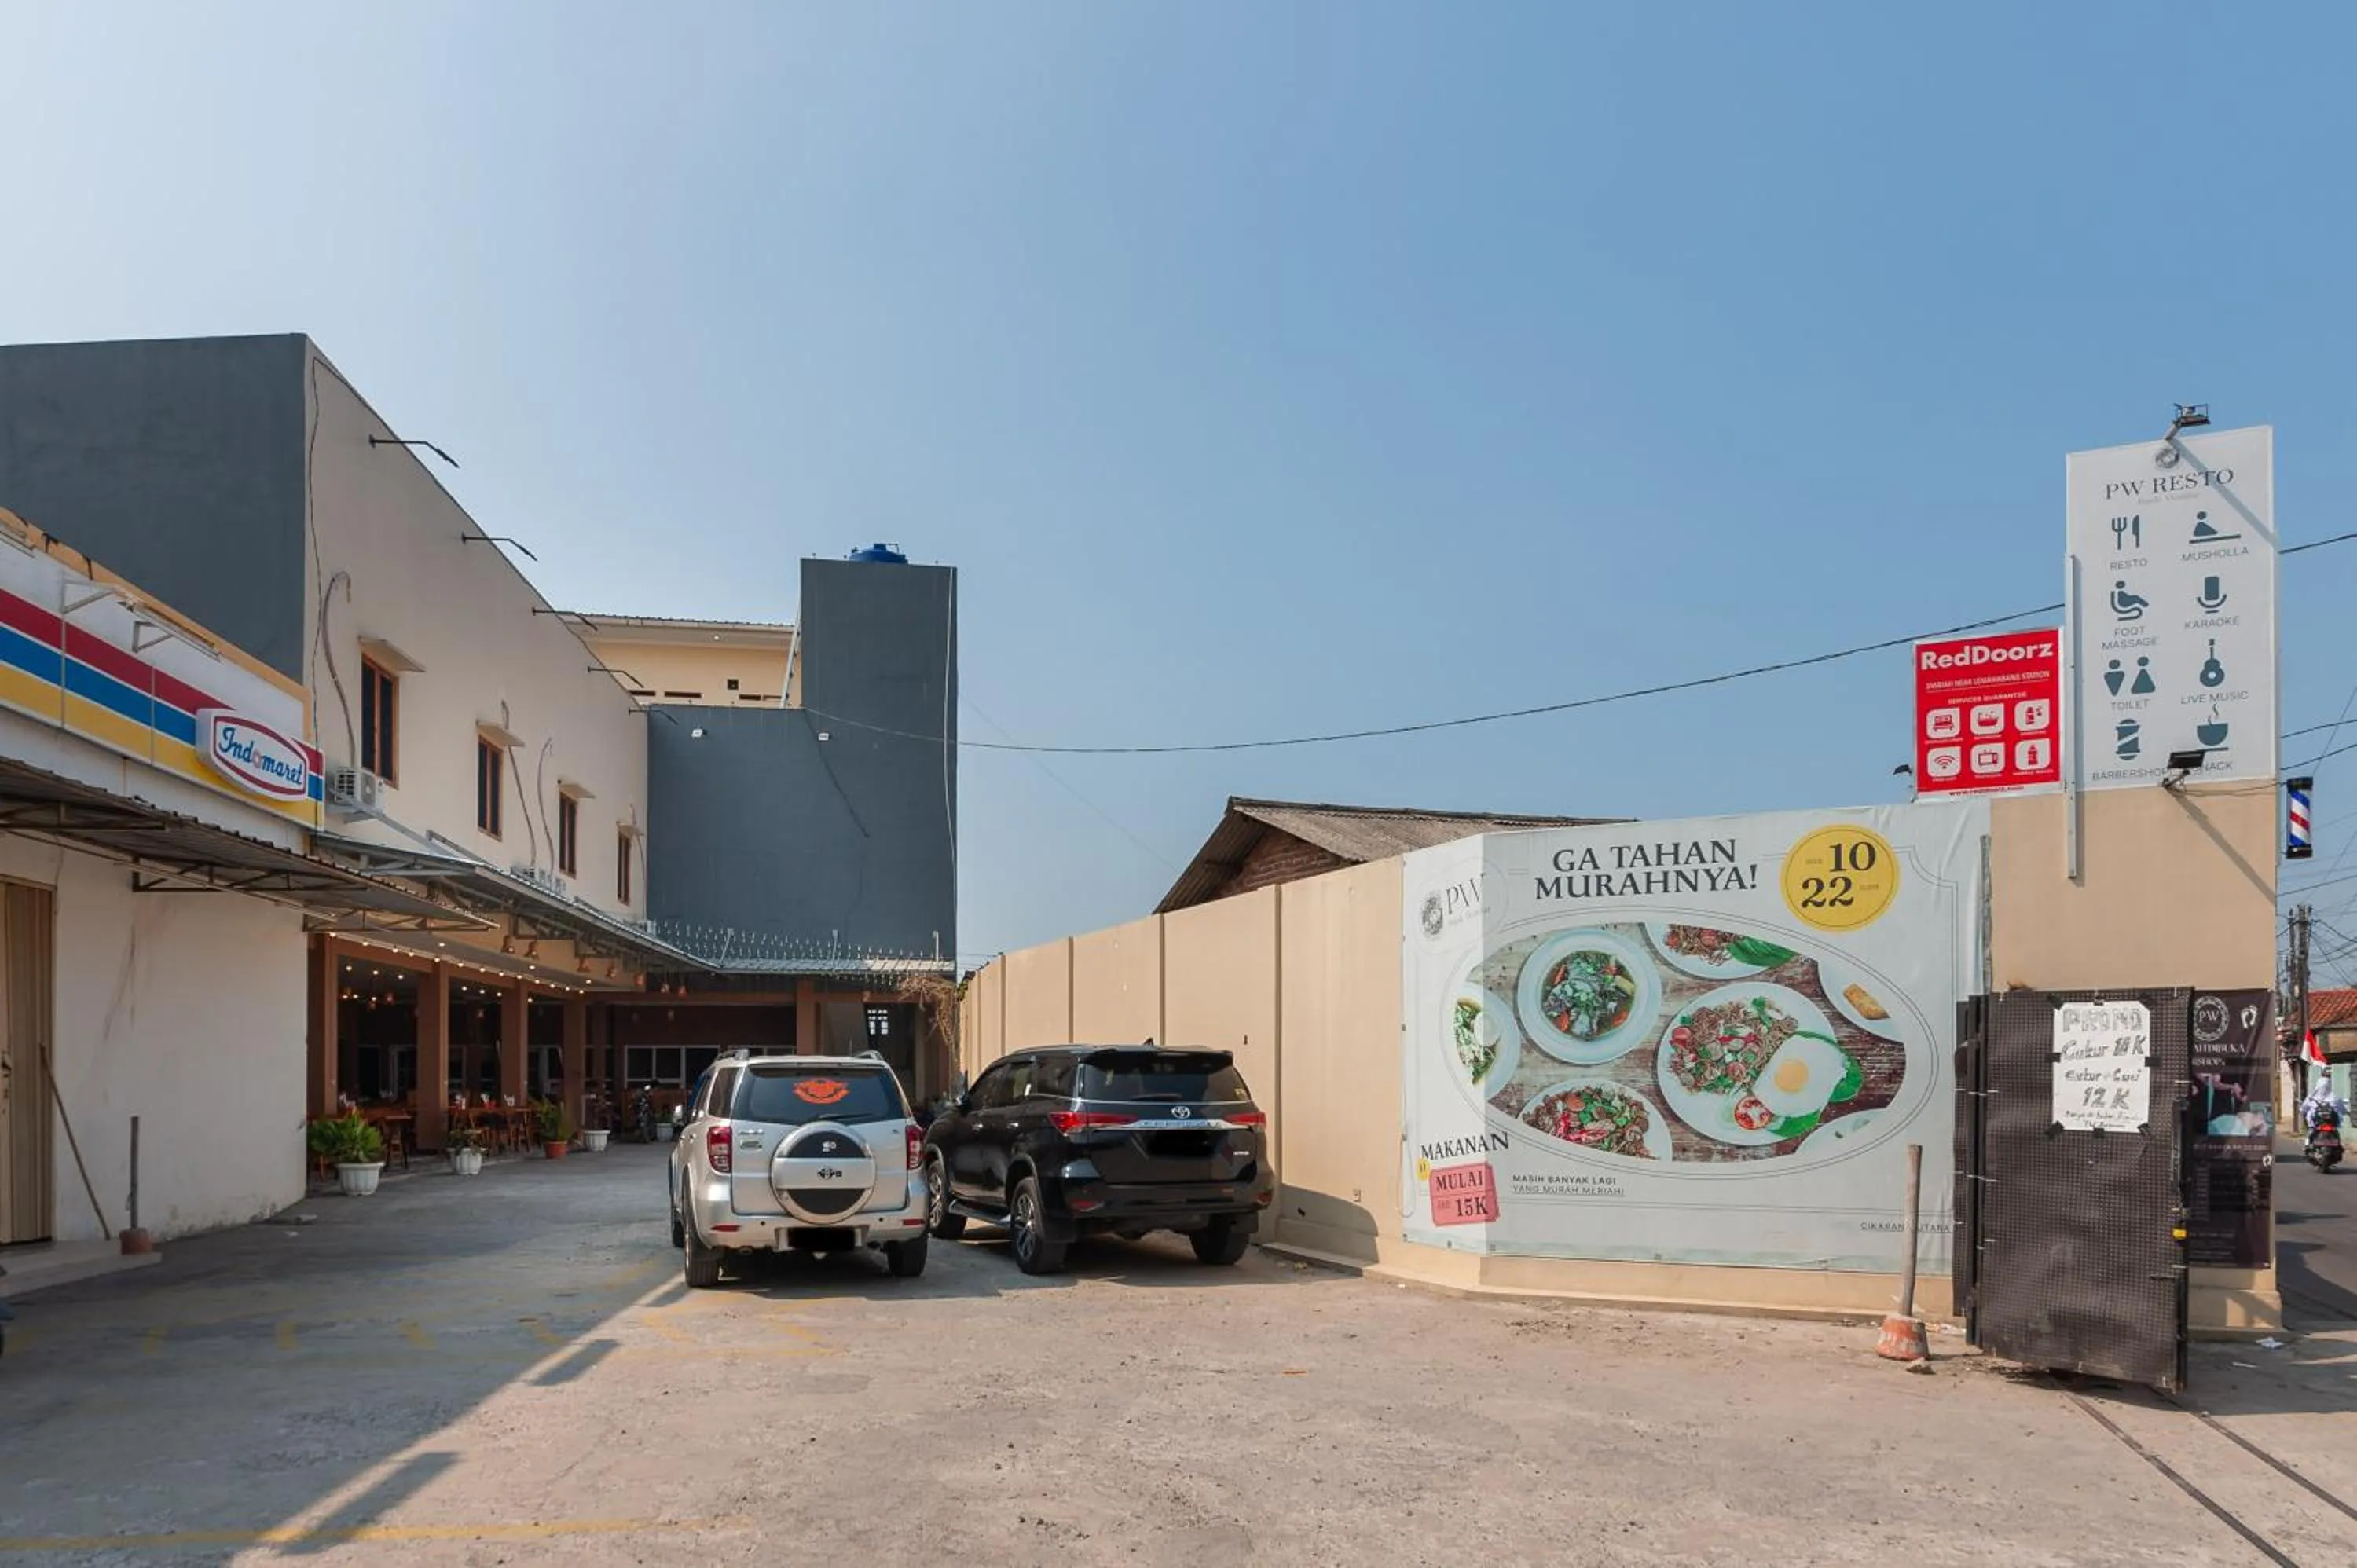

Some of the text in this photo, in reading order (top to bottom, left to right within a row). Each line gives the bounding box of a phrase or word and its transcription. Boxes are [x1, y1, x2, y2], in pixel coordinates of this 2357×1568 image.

[2106, 479, 2144, 500] PW
[2153, 467, 2234, 493] RESTO
[2182, 547, 2249, 562] MUSHOLLA
[2110, 558, 2148, 570] RESTO
[2113, 626, 2145, 636] FOOT
[2184, 616, 2239, 629] KARAOKE
[2102, 637, 2157, 650] MASSAGE
[1921, 643, 2053, 670] RedDoorz
[2110, 699, 2150, 711] TOILET
[2181, 691, 2249, 705] LIVE MUSIC
[218, 727, 303, 785] Indomaret
[1553, 839, 1736, 872] GA TAHAN
[1829, 841, 1876, 872] 10
[1535, 865, 1758, 899] MURAHNYA!
[1801, 876, 1854, 908] 22
[2199, 1009, 2220, 1022] PW
[1421, 1131, 1509, 1160] MAKANAN
[1436, 1171, 1483, 1191] MULAI
[1512, 1174, 1544, 1183] MASIH
[1456, 1196, 1488, 1217] 15K
[1860, 1222, 1907, 1232] CIKARAN
